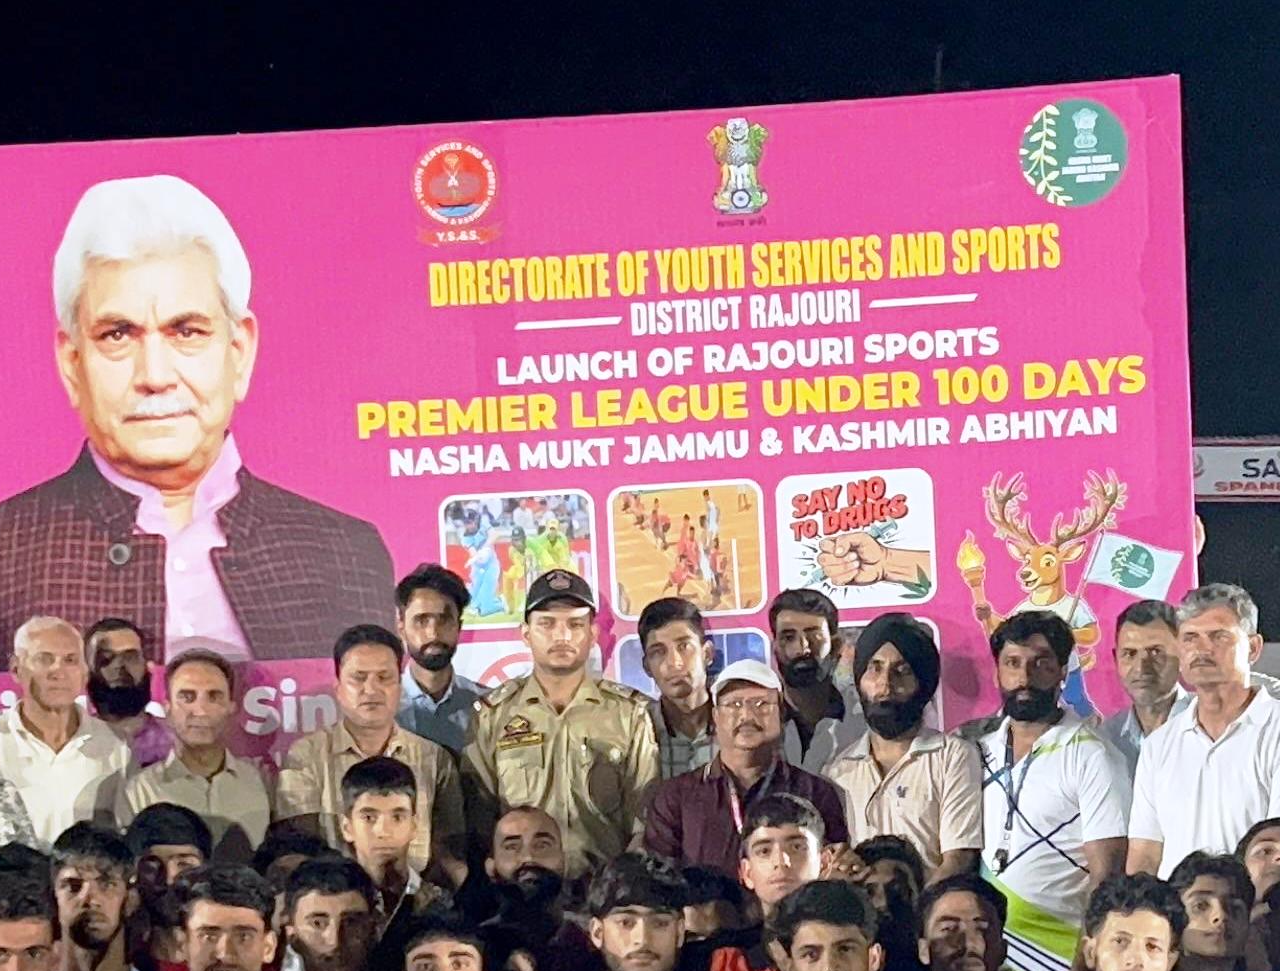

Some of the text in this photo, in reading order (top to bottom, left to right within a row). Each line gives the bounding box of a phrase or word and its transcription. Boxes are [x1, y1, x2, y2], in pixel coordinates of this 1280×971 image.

[429, 222, 1061, 307] DIRECTORATE OF YOUTH SERVICES AND SPORTS
[630, 288, 862, 337] DISTRICT RAJOURI
[496, 326, 1000, 386] LAUNCH OF RAJOURI SPORTS
[356, 354, 1148, 440] PREMIER LEAGUE UNDER 100 DAYS
[389, 405, 1118, 477] NASHA MUKT JAMMU & KASHMIR ABHIYAN
[789, 494, 909, 541] TO DRUGS
[791, 476, 886, 519] SAY NO
